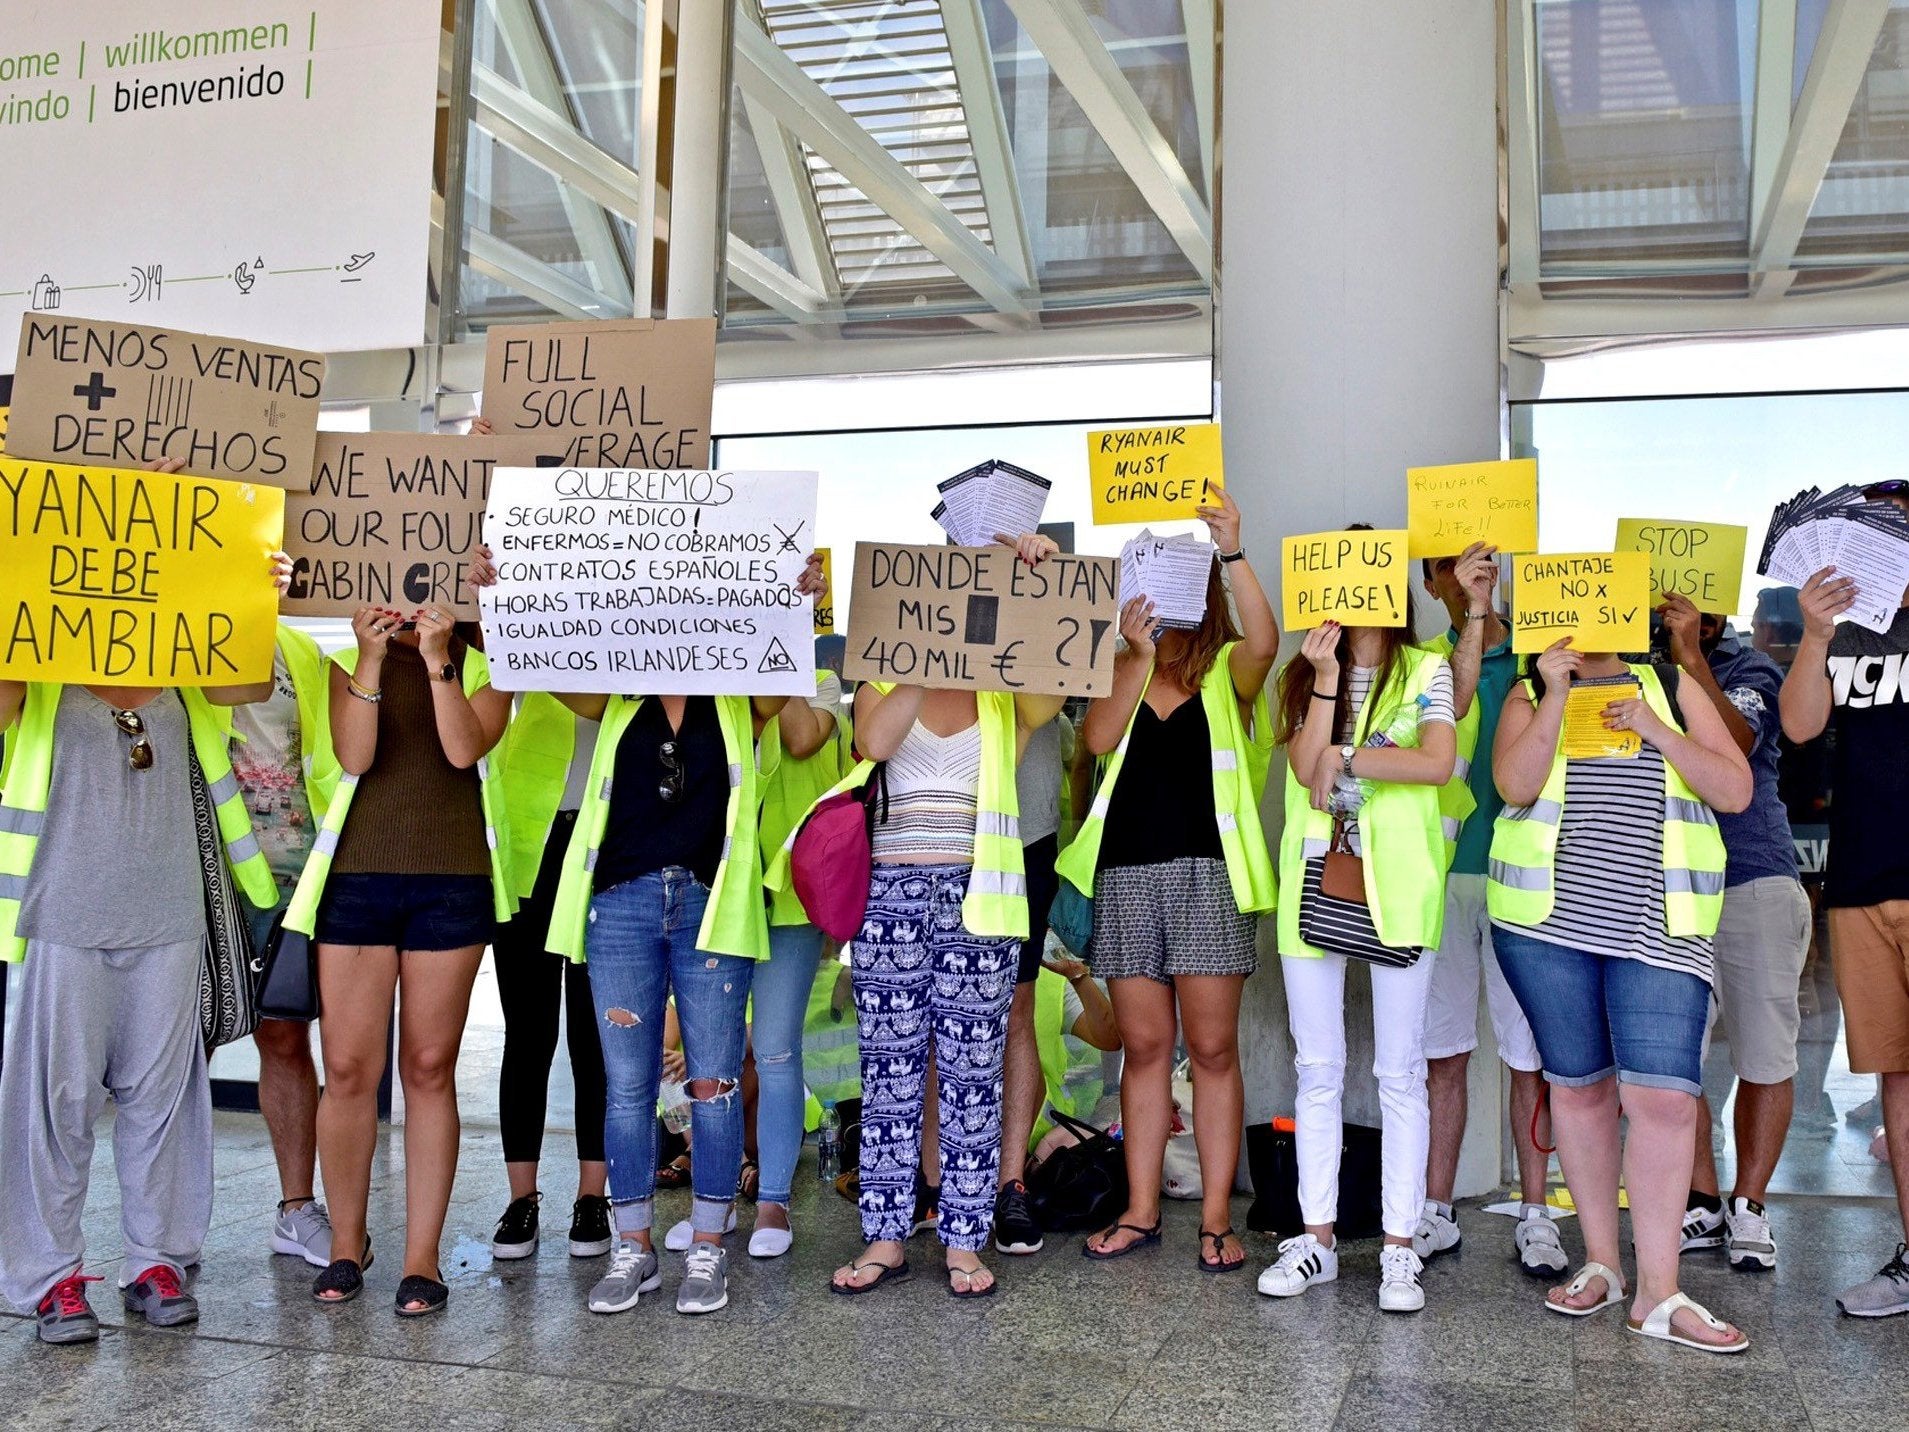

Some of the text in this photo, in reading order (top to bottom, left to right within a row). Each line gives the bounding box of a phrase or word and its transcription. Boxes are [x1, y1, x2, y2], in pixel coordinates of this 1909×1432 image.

[106, 24, 287, 70] willkommen
[115, 65, 283, 112] bienvenido
[27, 322, 320, 398] MENOS VENTAS
[503, 337, 595, 383] FULL
[515, 386, 663, 428] SOCIAL
[53, 414, 287, 474] DERECHOS
[1101, 427, 1185, 456] RYANAIR
[310, 444, 496, 500] WE WANT
[1115, 454, 1169, 478] MUST
[555, 467, 733, 507] QUEREMOS
[1106, 478, 1209, 503] CHANGE!
[0, 467, 222, 551] YANAIR
[506, 506, 595, 526] SEGURO
[302, 509, 388, 547] OUR
[665, 532, 770, 552] COBRAMOS
[1636, 527, 1708, 558] STOP
[50, 545, 159, 597] DEBE
[499, 556, 777, 583] CONTRATOS ESPAÑOLES
[1294, 540, 1391, 571] HELP US
[1524, 558, 1613, 583] CHANTAJE
[403, 562, 480, 605] CRE
[872, 549, 993, 591] DONDE
[1011, 554, 1115, 605] ESTAN
[1562, 580, 1588, 599] NO
[495, 592, 568, 614] HORAS
[899, 600, 955, 635] MIS
[1299, 585, 1399, 620] PLEASE!
[1517, 606, 1616, 626] JUSTICIA SI
[6, 600, 238, 677] AMBIAR
[499, 618, 756, 638] IGUALDAD CONDICIONES
[508, 651, 597, 670] BANCOS
[608, 646, 747, 672] IRLANDESES
